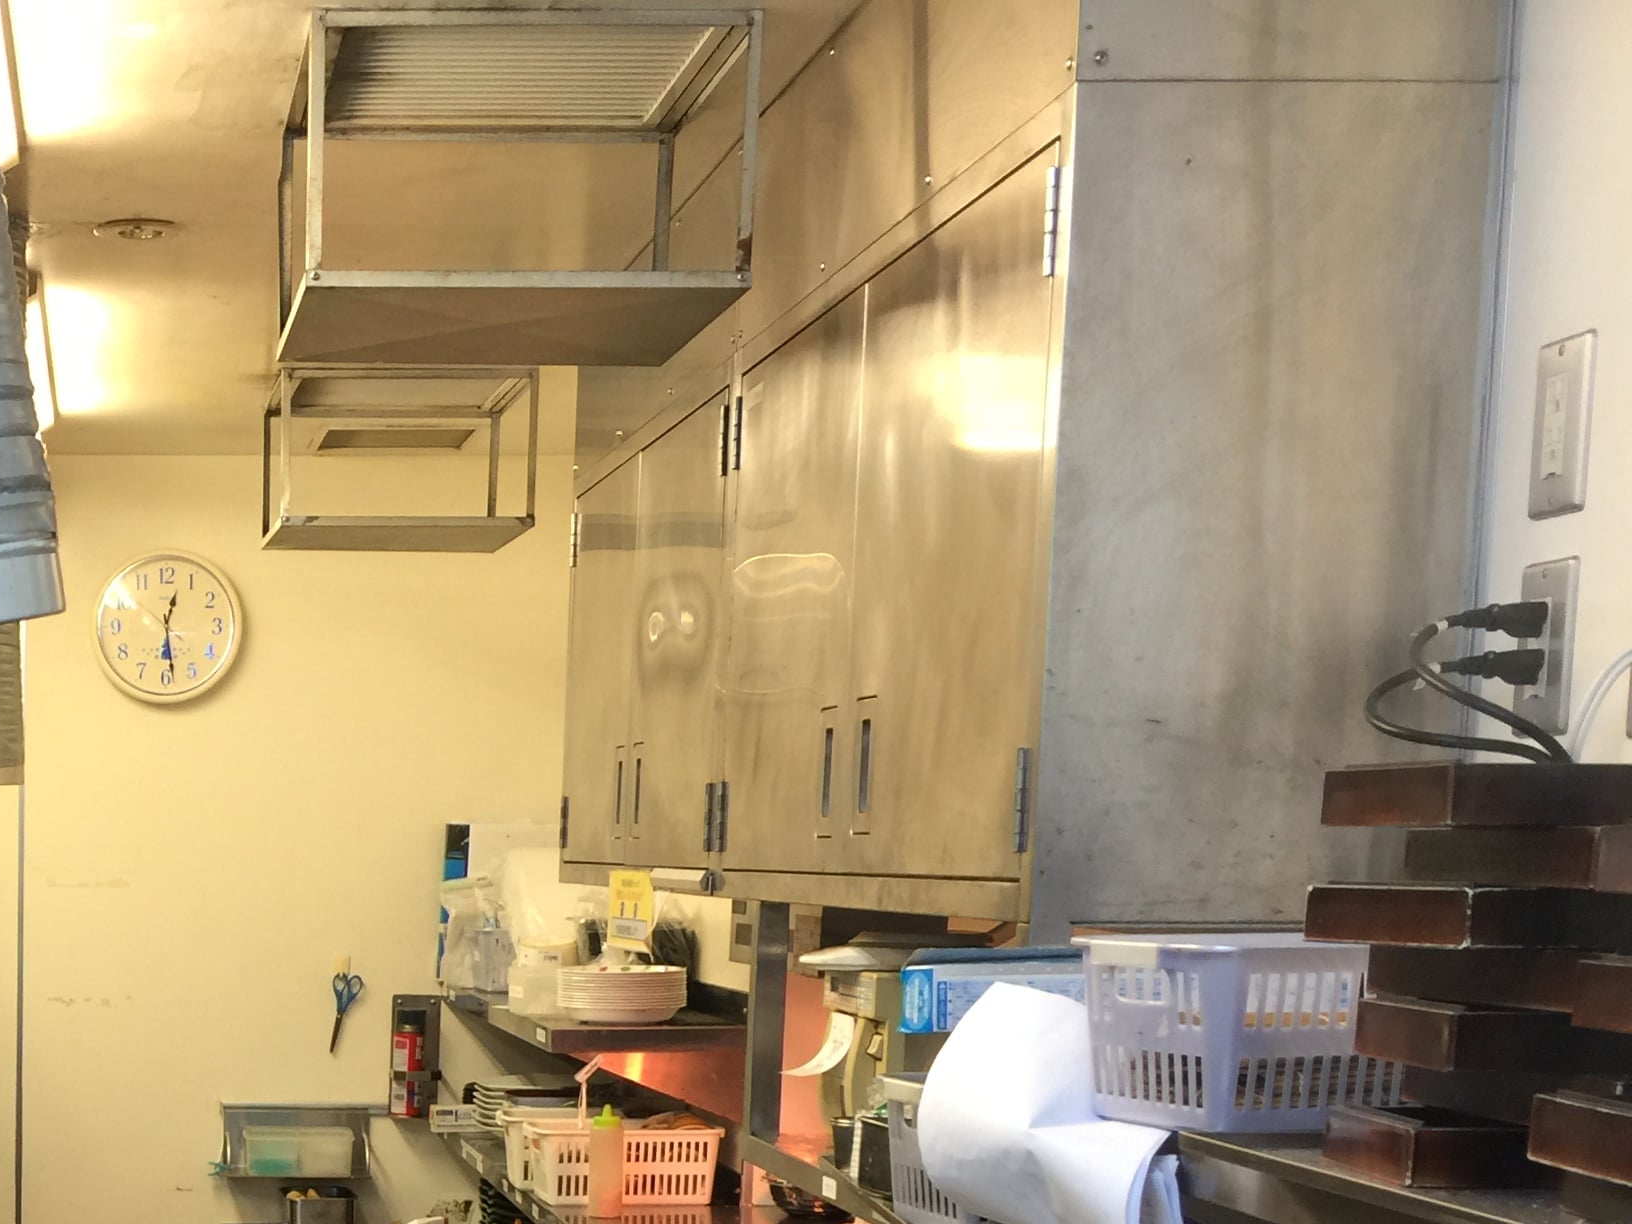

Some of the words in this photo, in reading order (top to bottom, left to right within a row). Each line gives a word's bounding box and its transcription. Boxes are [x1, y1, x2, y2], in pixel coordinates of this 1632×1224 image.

[136, 573, 148, 590] 11
[159, 566, 175, 584] 12
[204, 592, 215, 609] 2
[110, 618, 121, 635] 9
[211, 617, 222, 635] 3
[118, 643, 128, 660] 8
[204, 642, 215, 659] 4
[136, 662, 146, 680] 7
[160, 669, 171, 686] 6
[187, 663, 197, 679] 5
